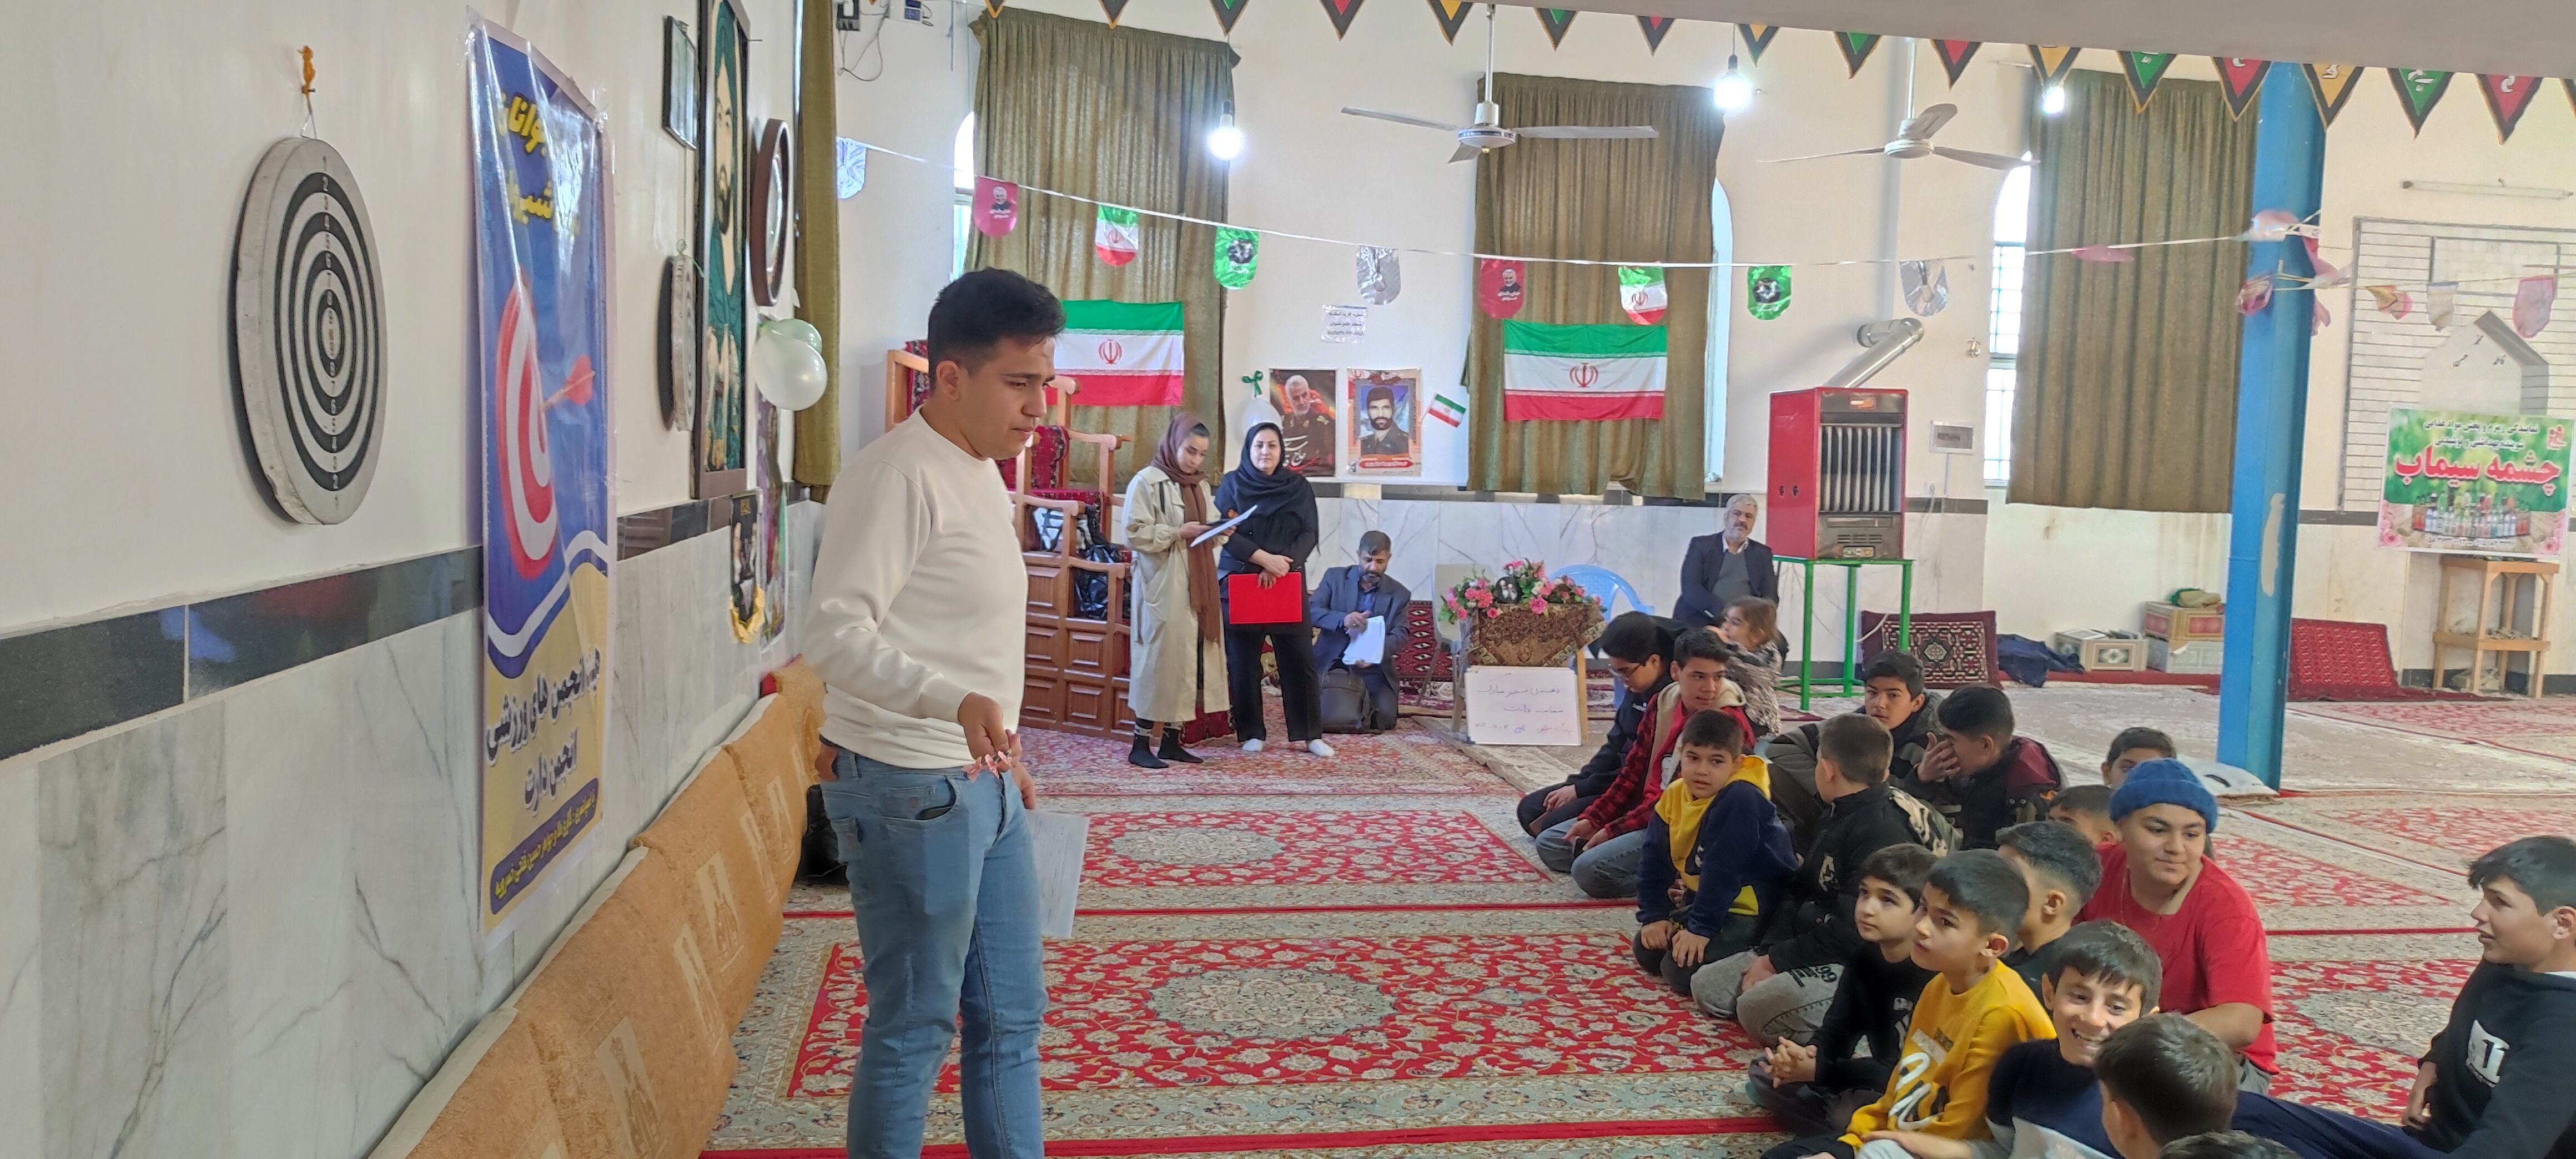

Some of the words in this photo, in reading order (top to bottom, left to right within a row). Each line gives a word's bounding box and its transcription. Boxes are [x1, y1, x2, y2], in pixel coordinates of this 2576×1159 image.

[2394, 444, 2481, 488] سیماب
[2486, 449, 2562, 496] چشمه
[486, 693, 528, 764] ورزشی
[524, 750, 547, 814] دارت
[550, 726, 578, 799] انجمن
